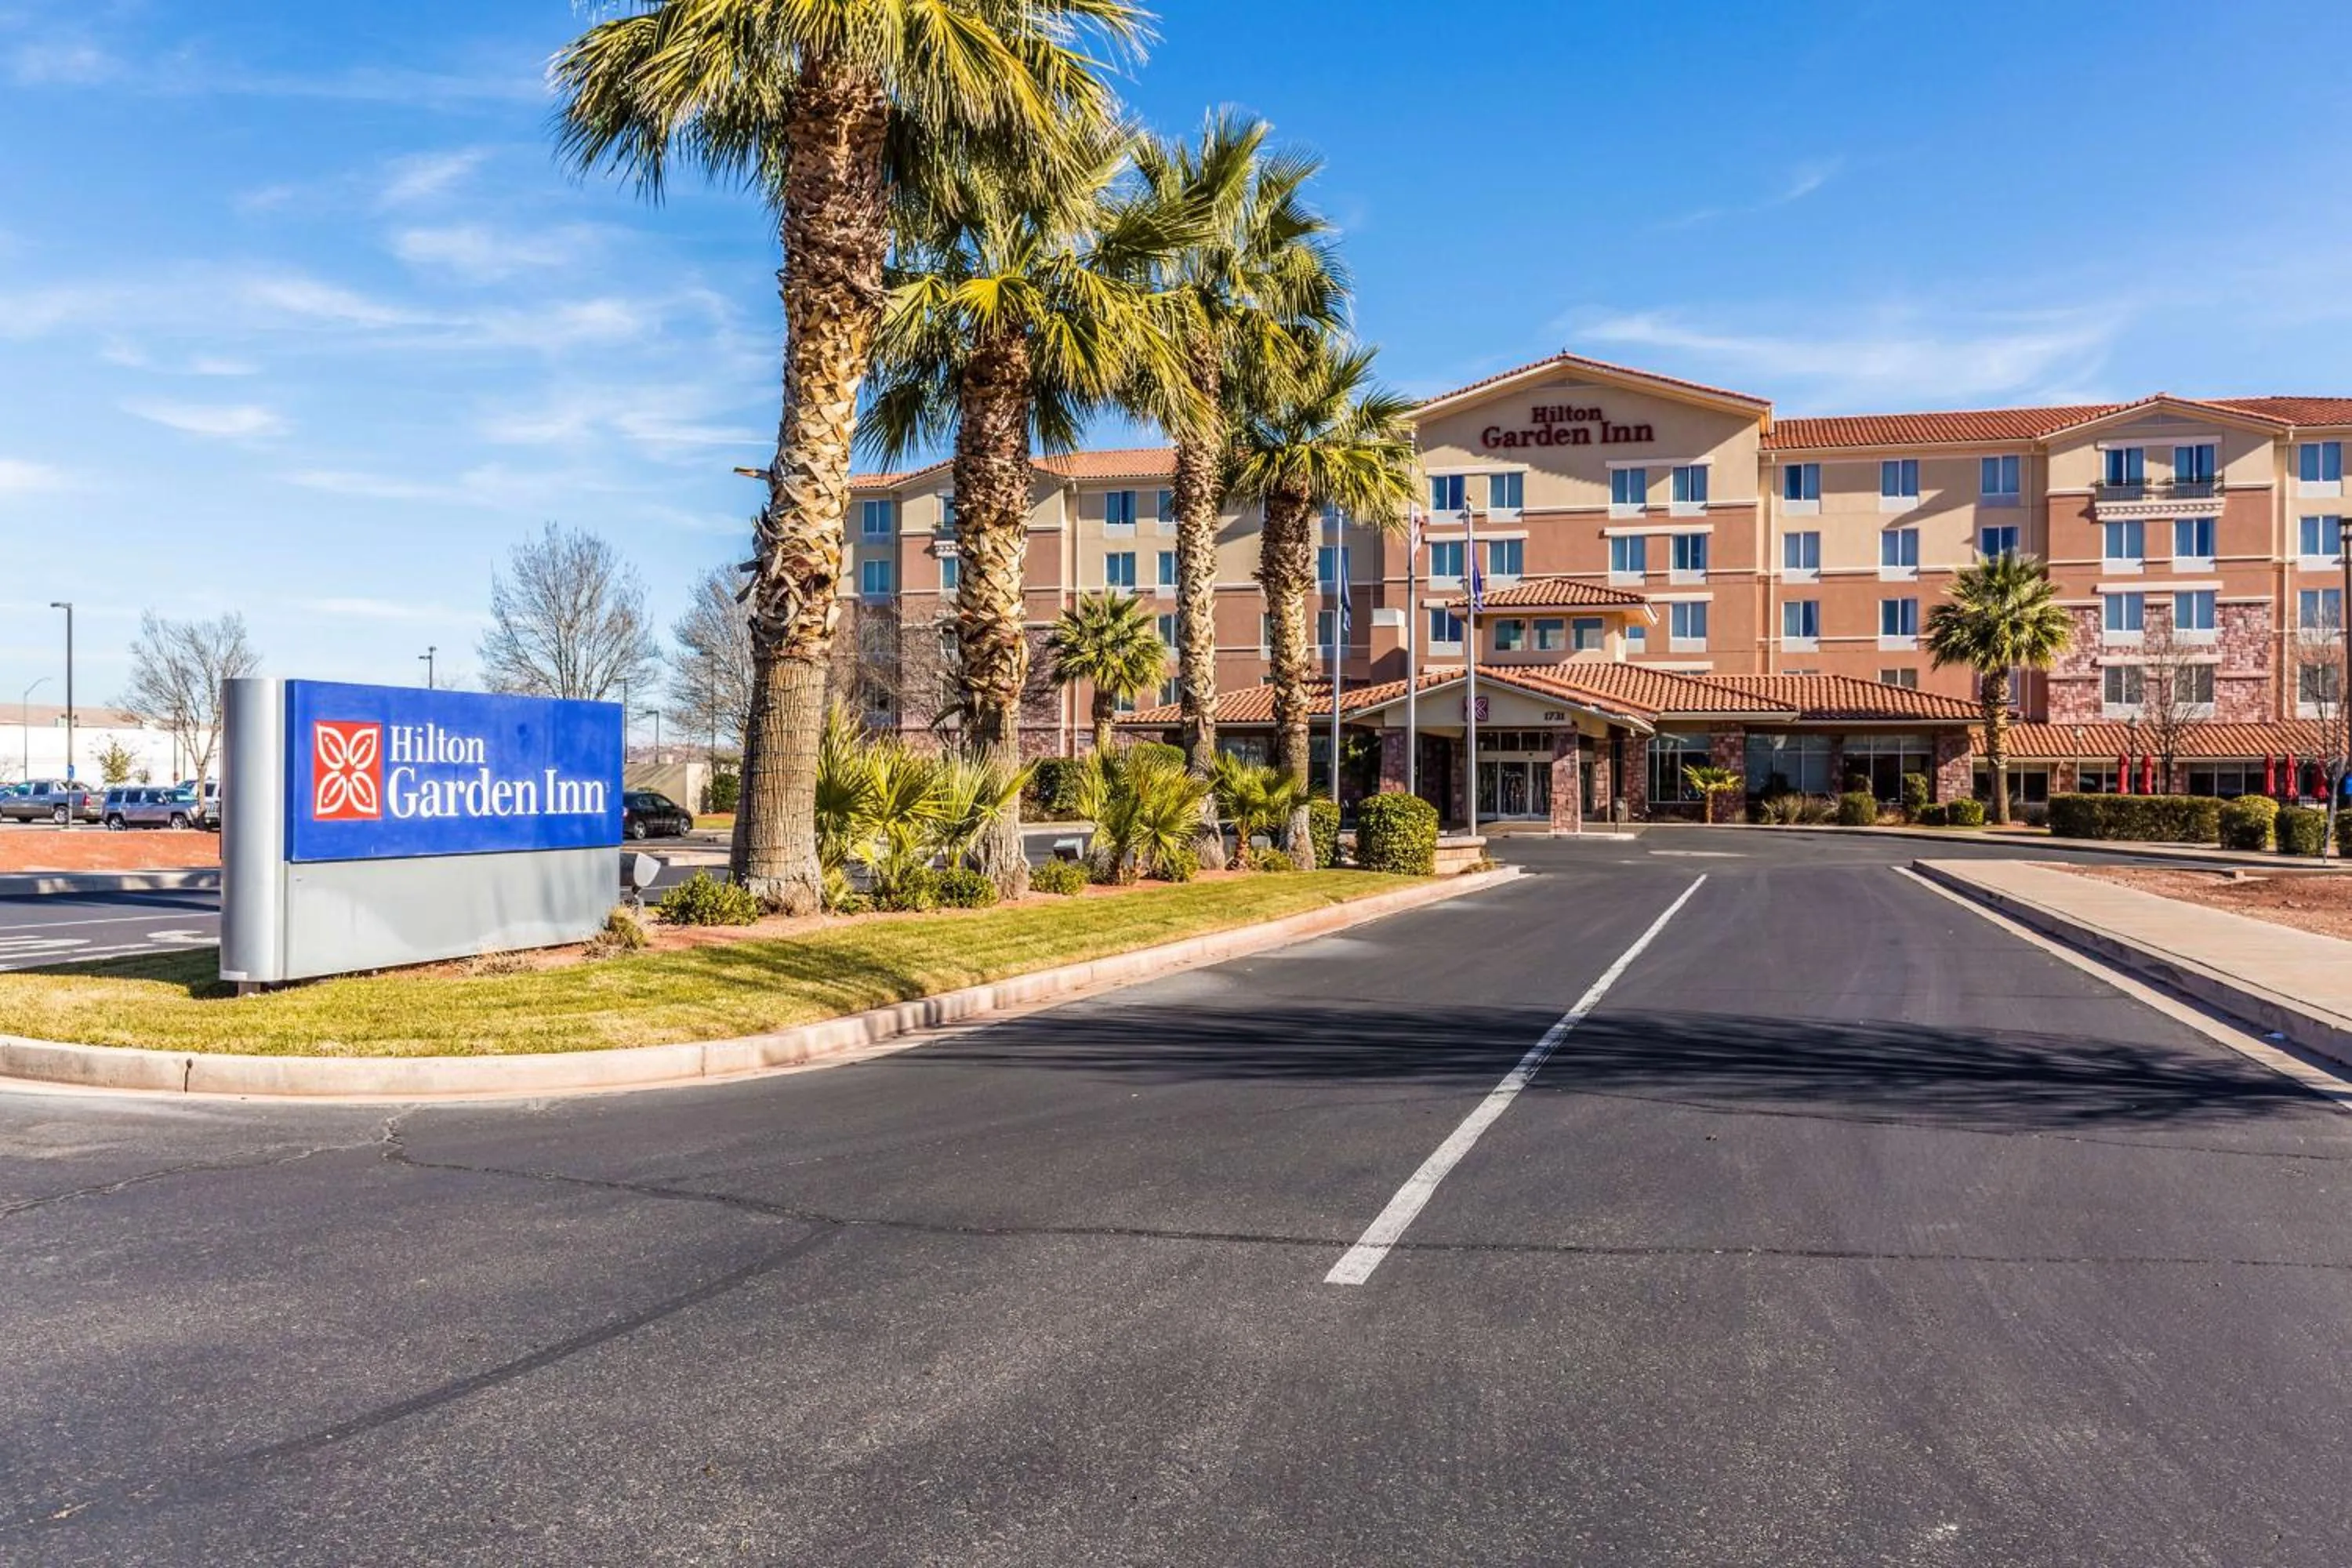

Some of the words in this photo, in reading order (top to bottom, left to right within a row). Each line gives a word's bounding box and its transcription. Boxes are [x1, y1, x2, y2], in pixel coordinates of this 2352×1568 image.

[1531, 405, 1602, 423] Hilton
[1481, 424, 1591, 448] Garden
[1600, 421, 1654, 444] Inn
[1544, 711, 1565, 720] 1731
[389, 723, 485, 764] Hilton
[388, 767, 539, 818] Garden
[545, 769, 608, 814] Inn
